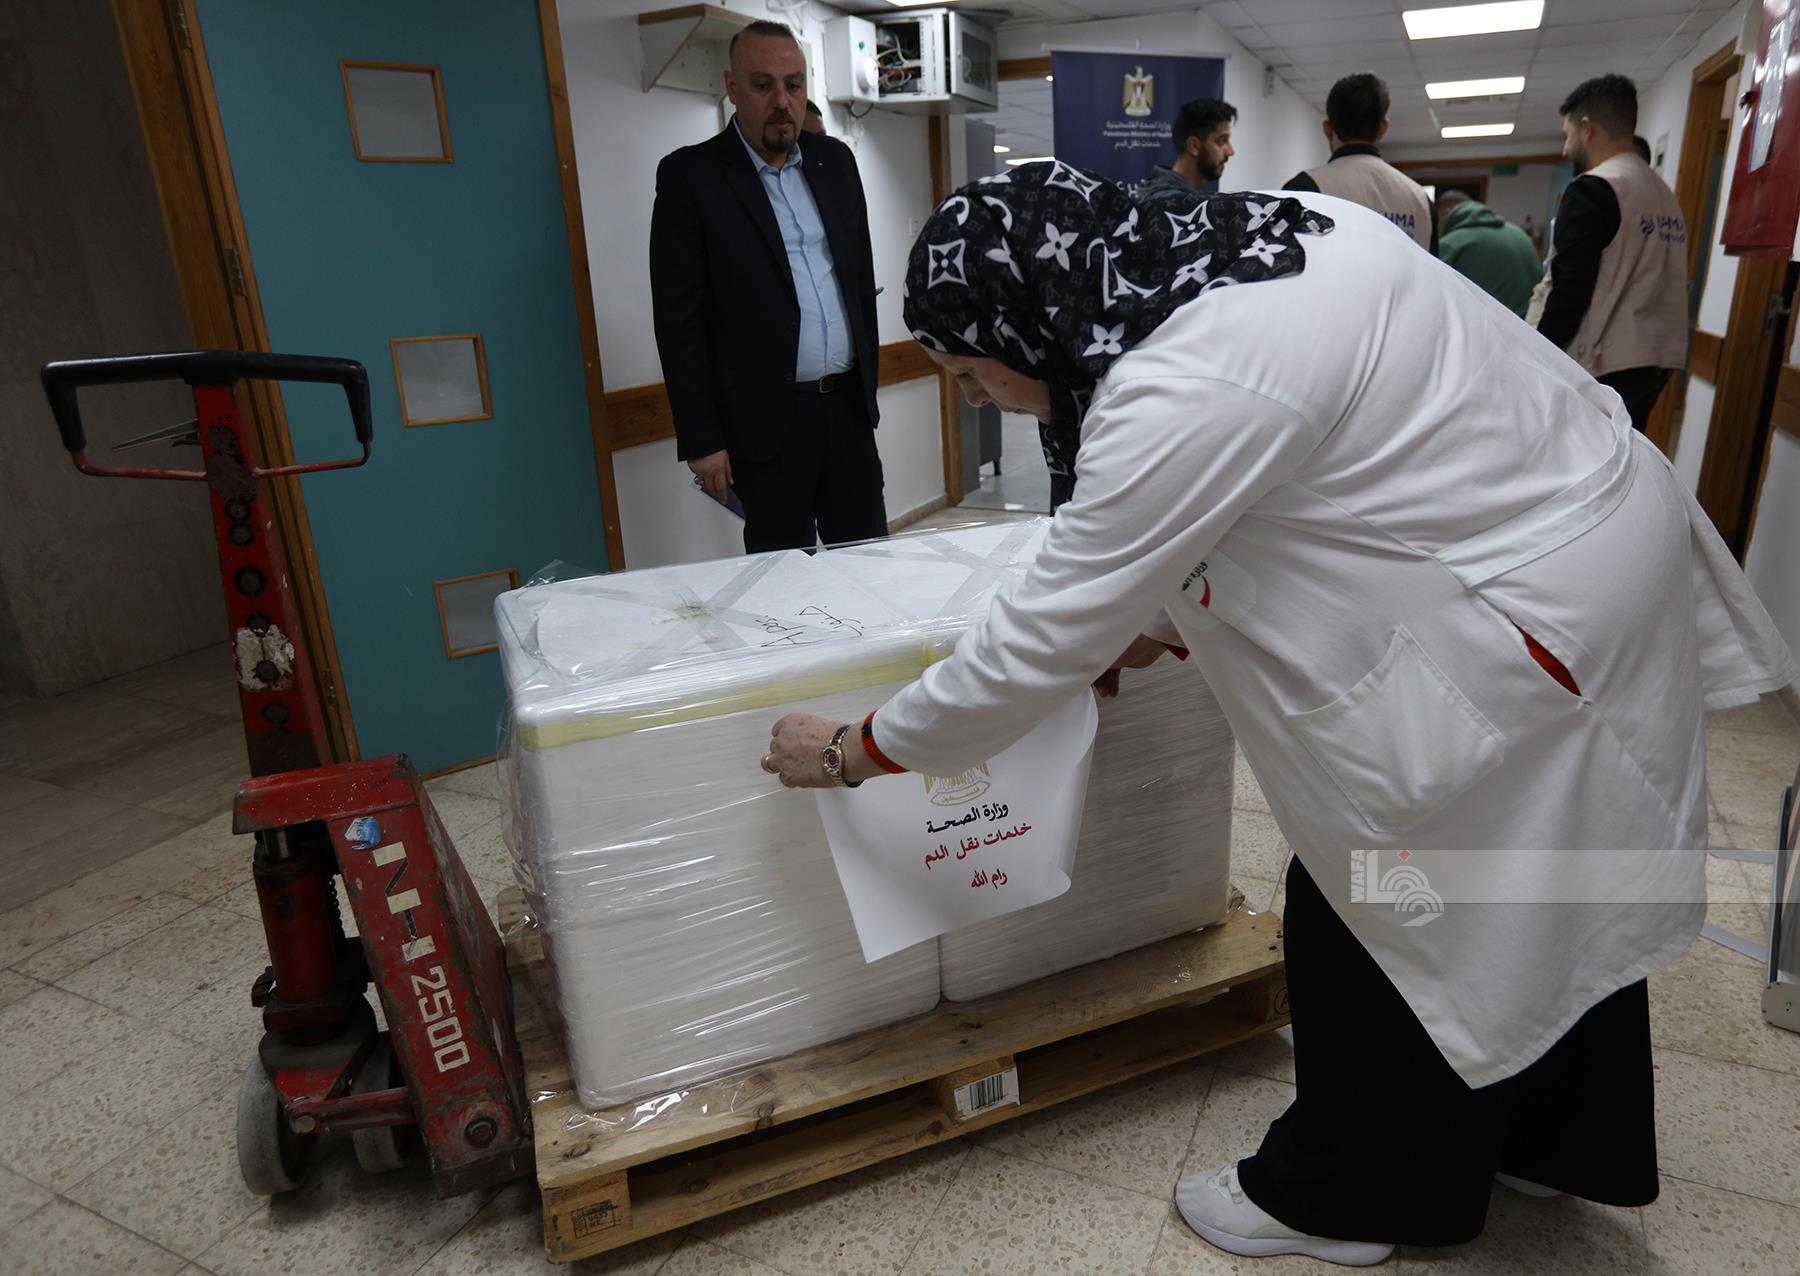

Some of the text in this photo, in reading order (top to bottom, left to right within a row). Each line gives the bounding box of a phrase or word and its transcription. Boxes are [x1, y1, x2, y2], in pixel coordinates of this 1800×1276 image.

[926, 801, 1010, 834] وزارة الصحة
[924, 823, 1032, 870] خدمات نقل الدم
[970, 868, 1008, 890] رام الله
[411, 965, 471, 1074] 2500
